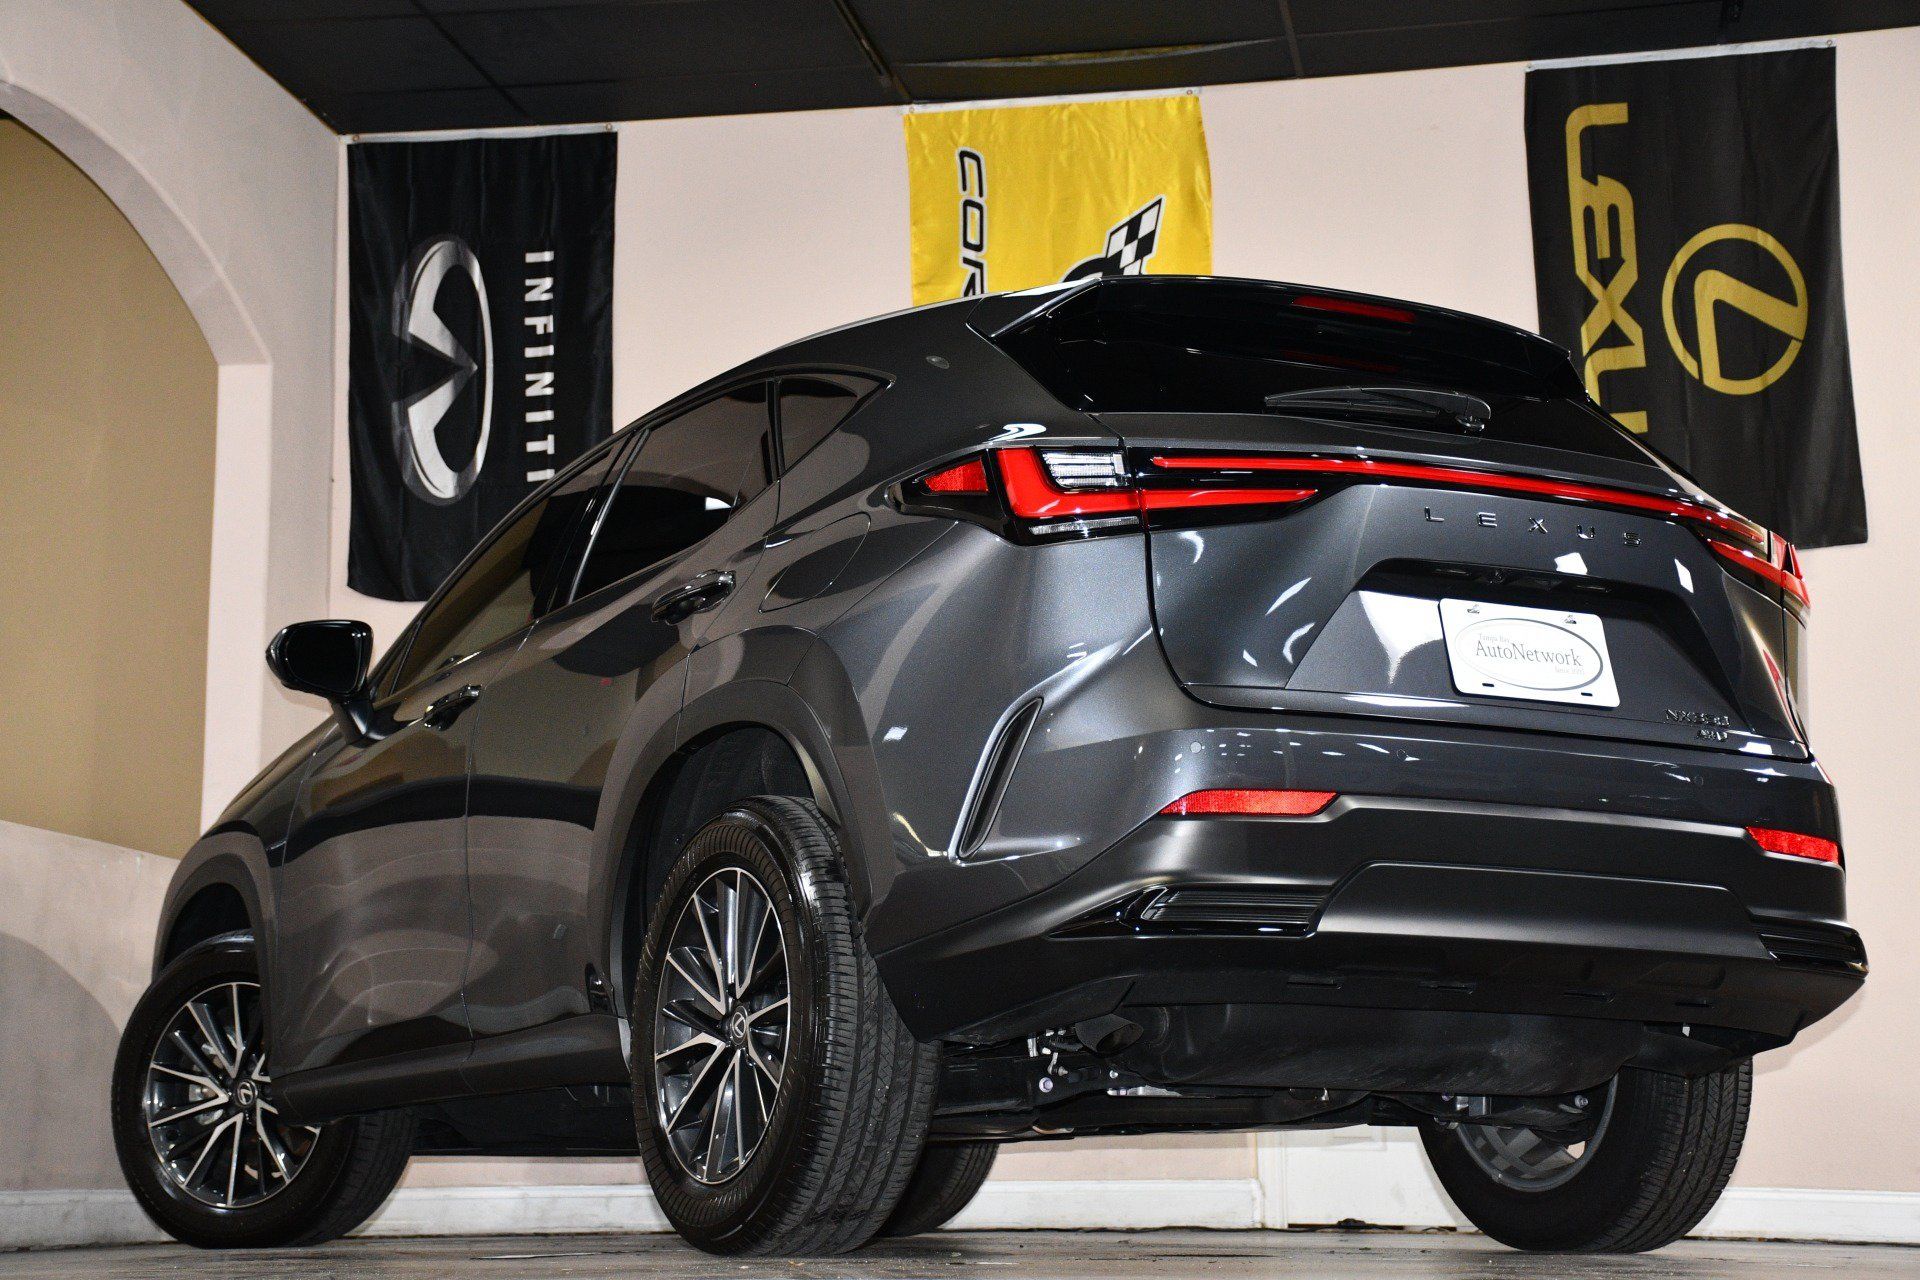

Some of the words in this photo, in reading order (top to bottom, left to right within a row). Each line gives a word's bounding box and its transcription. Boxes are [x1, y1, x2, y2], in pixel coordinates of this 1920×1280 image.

[524, 250, 556, 482] INFINITI
[1424, 505, 1642, 547] LEXUS
[1475, 640, 1584, 667] AutoNetwork
